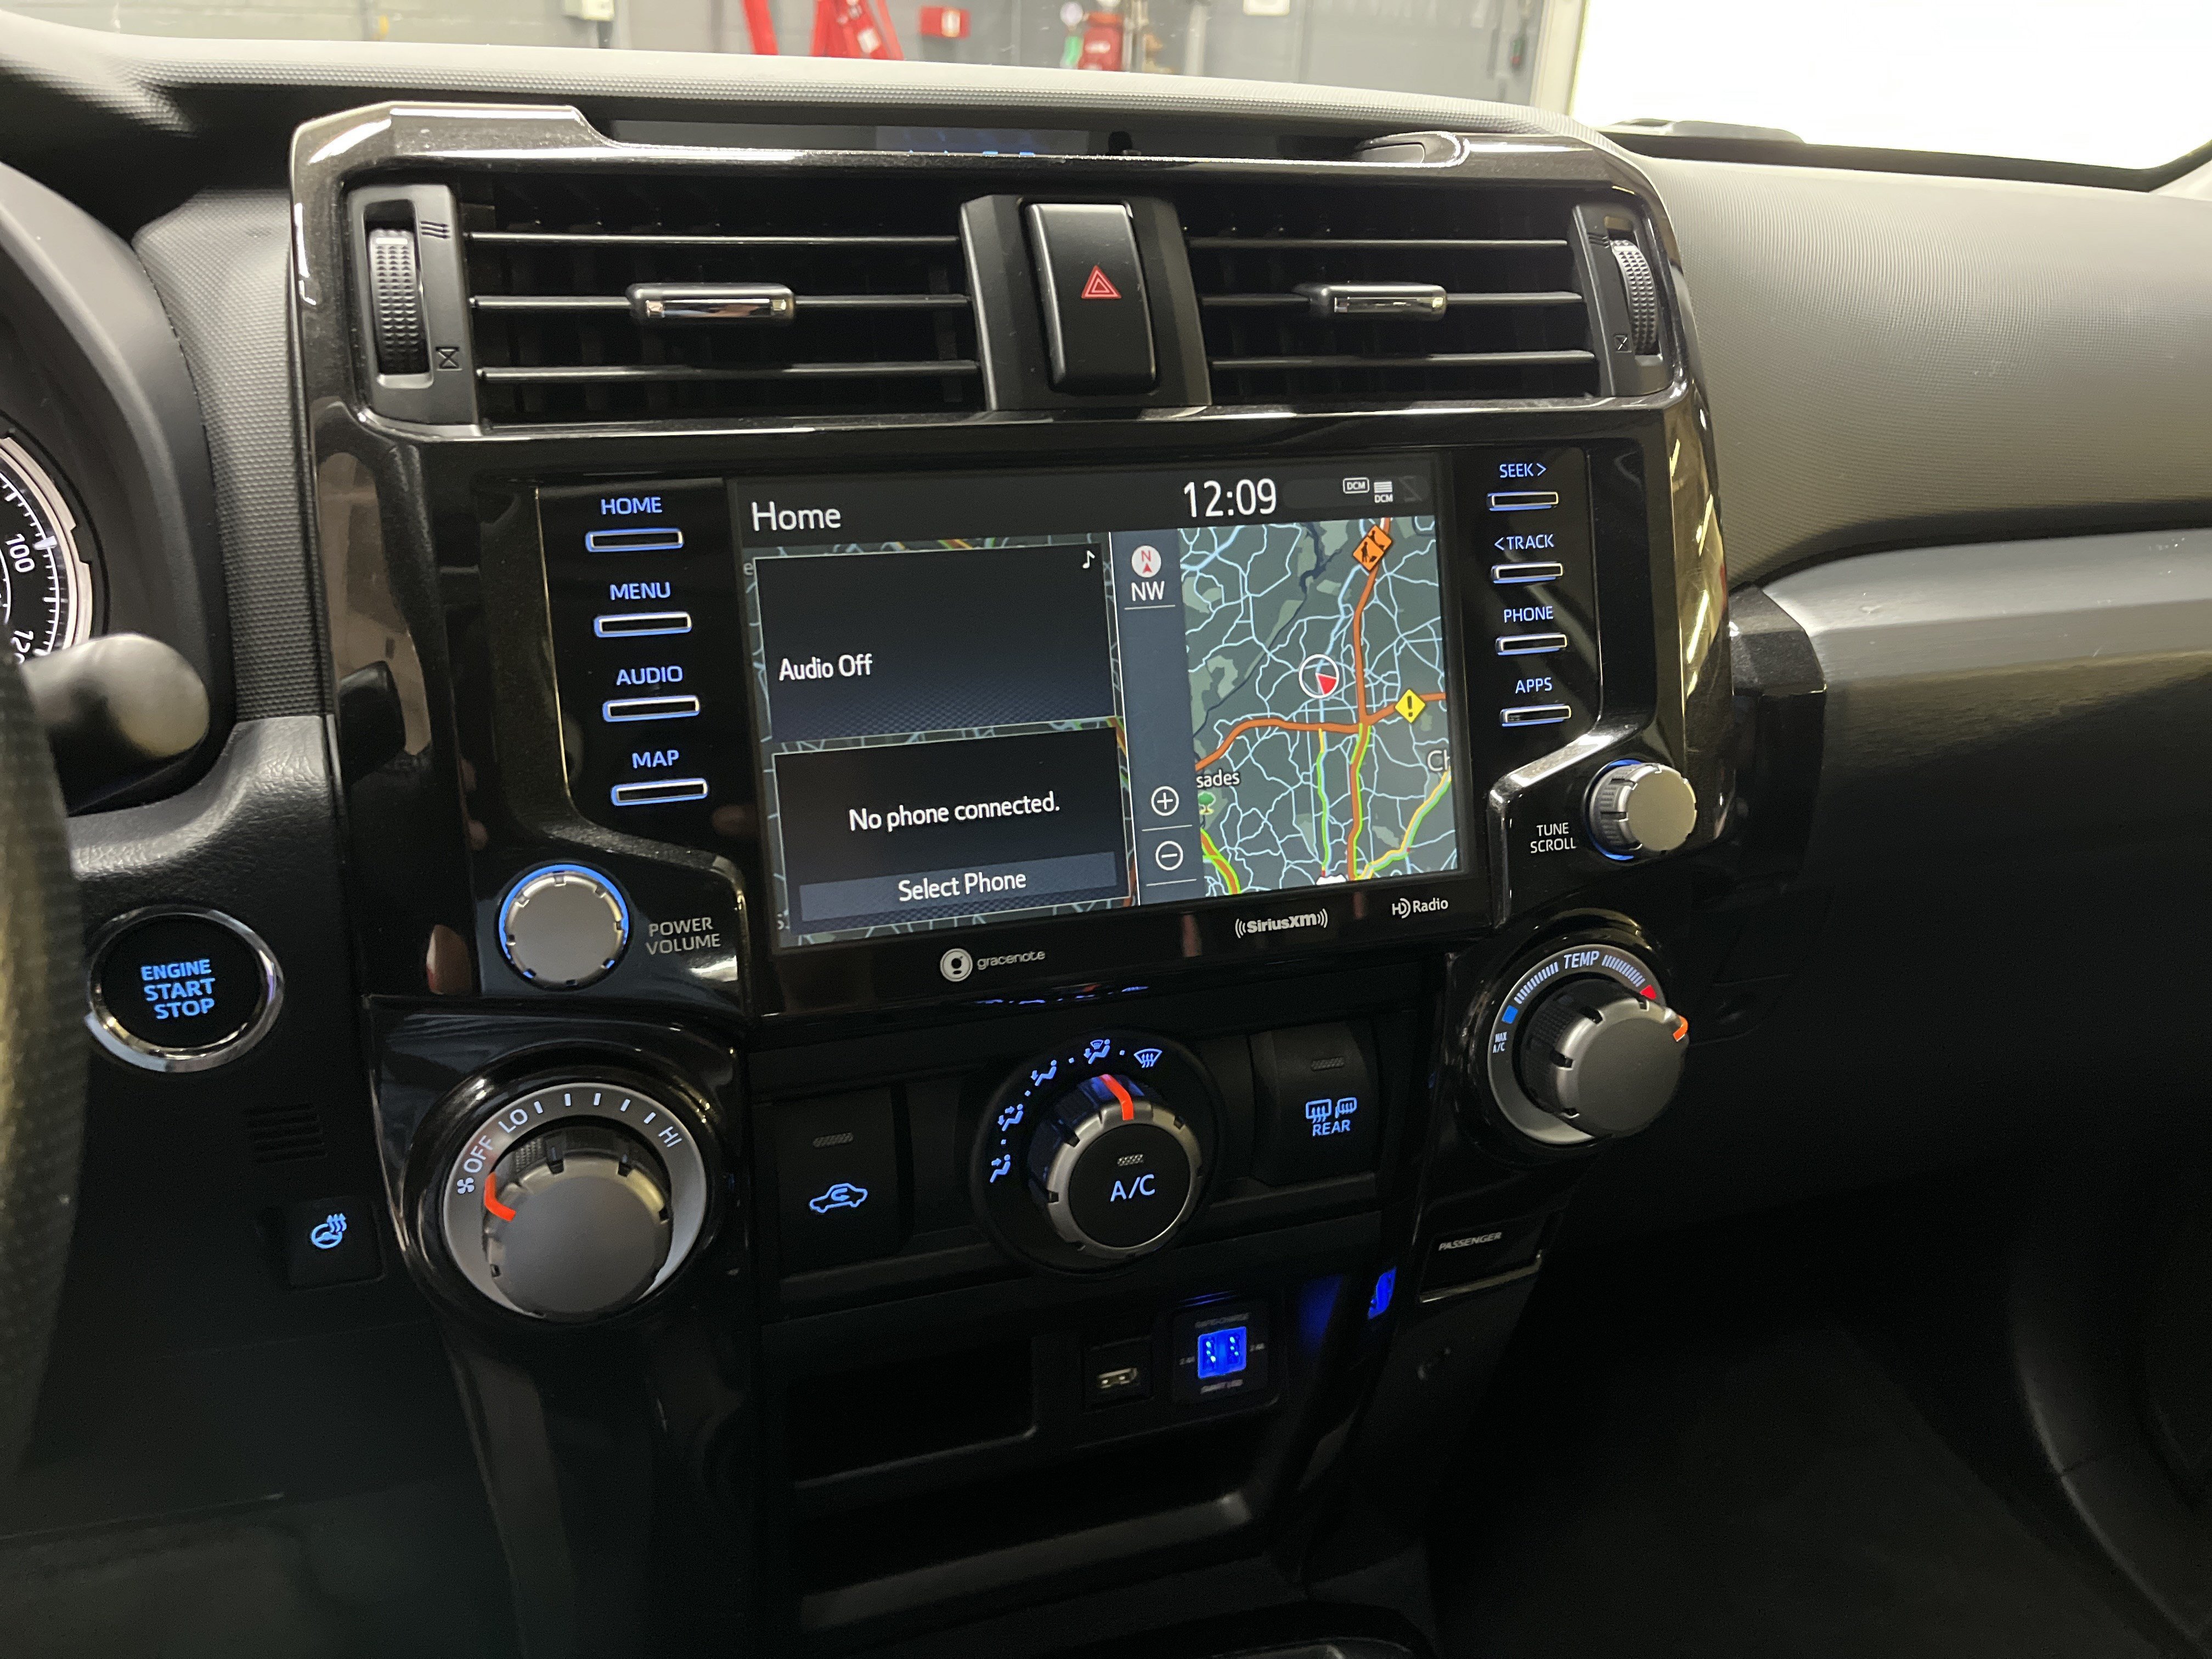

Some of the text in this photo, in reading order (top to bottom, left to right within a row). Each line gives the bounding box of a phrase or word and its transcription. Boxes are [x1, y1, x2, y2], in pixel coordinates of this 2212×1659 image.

[1499, 463, 1534, 478] SEEK
[1347, 481, 1365, 490] DCM
[601, 496, 663, 515] HOME
[1183, 478, 1277, 517] 12:09
[1374, 494, 1393, 503] DCM
[751, 501, 841, 532] Home
[1506, 534, 1554, 550] TRACK
[5, 533, 35, 573] 100
[1141, 550, 1152, 561] N
[610, 582, 671, 601] MENU
[1131, 581, 1165, 601] NW
[1504, 606, 1554, 623] PHONE
[10, 630, 34, 664] 12
[616, 666, 683, 686] AUDIO
[779, 653, 872, 681] Audio Off
[1515, 677, 1553, 694] APPS
[632, 750, 679, 769] MAP
[1196, 769, 1240, 788] sades
[849, 791, 1060, 832] No phone connected.
[1536, 823, 1570, 836] TUNE
[1530, 838, 1576, 854] SCROLL
[898, 871, 1026, 901] Select Phone
[1413, 897, 1449, 913] Radio
[648, 917, 713, 936] POWER
[646, 933, 721, 955] VOLUME
[977, 951, 1046, 970] gracenote
[1563, 950, 1599, 969] TEMP
[140, 958, 212, 981] ENGINE
[144, 978, 216, 1002] START
[154, 997, 215, 1020] STOP
[1492, 1042, 1505, 1053] A/C
[498, 1108, 528, 1133] LO
[1312, 1119, 1351, 1137] REAR
[658, 1126, 683, 1148] HI
[463, 1135, 494, 1175] OFF
[1110, 1174, 1156, 1201] A/C
[1438, 1232, 1502, 1251] PASSENGER
